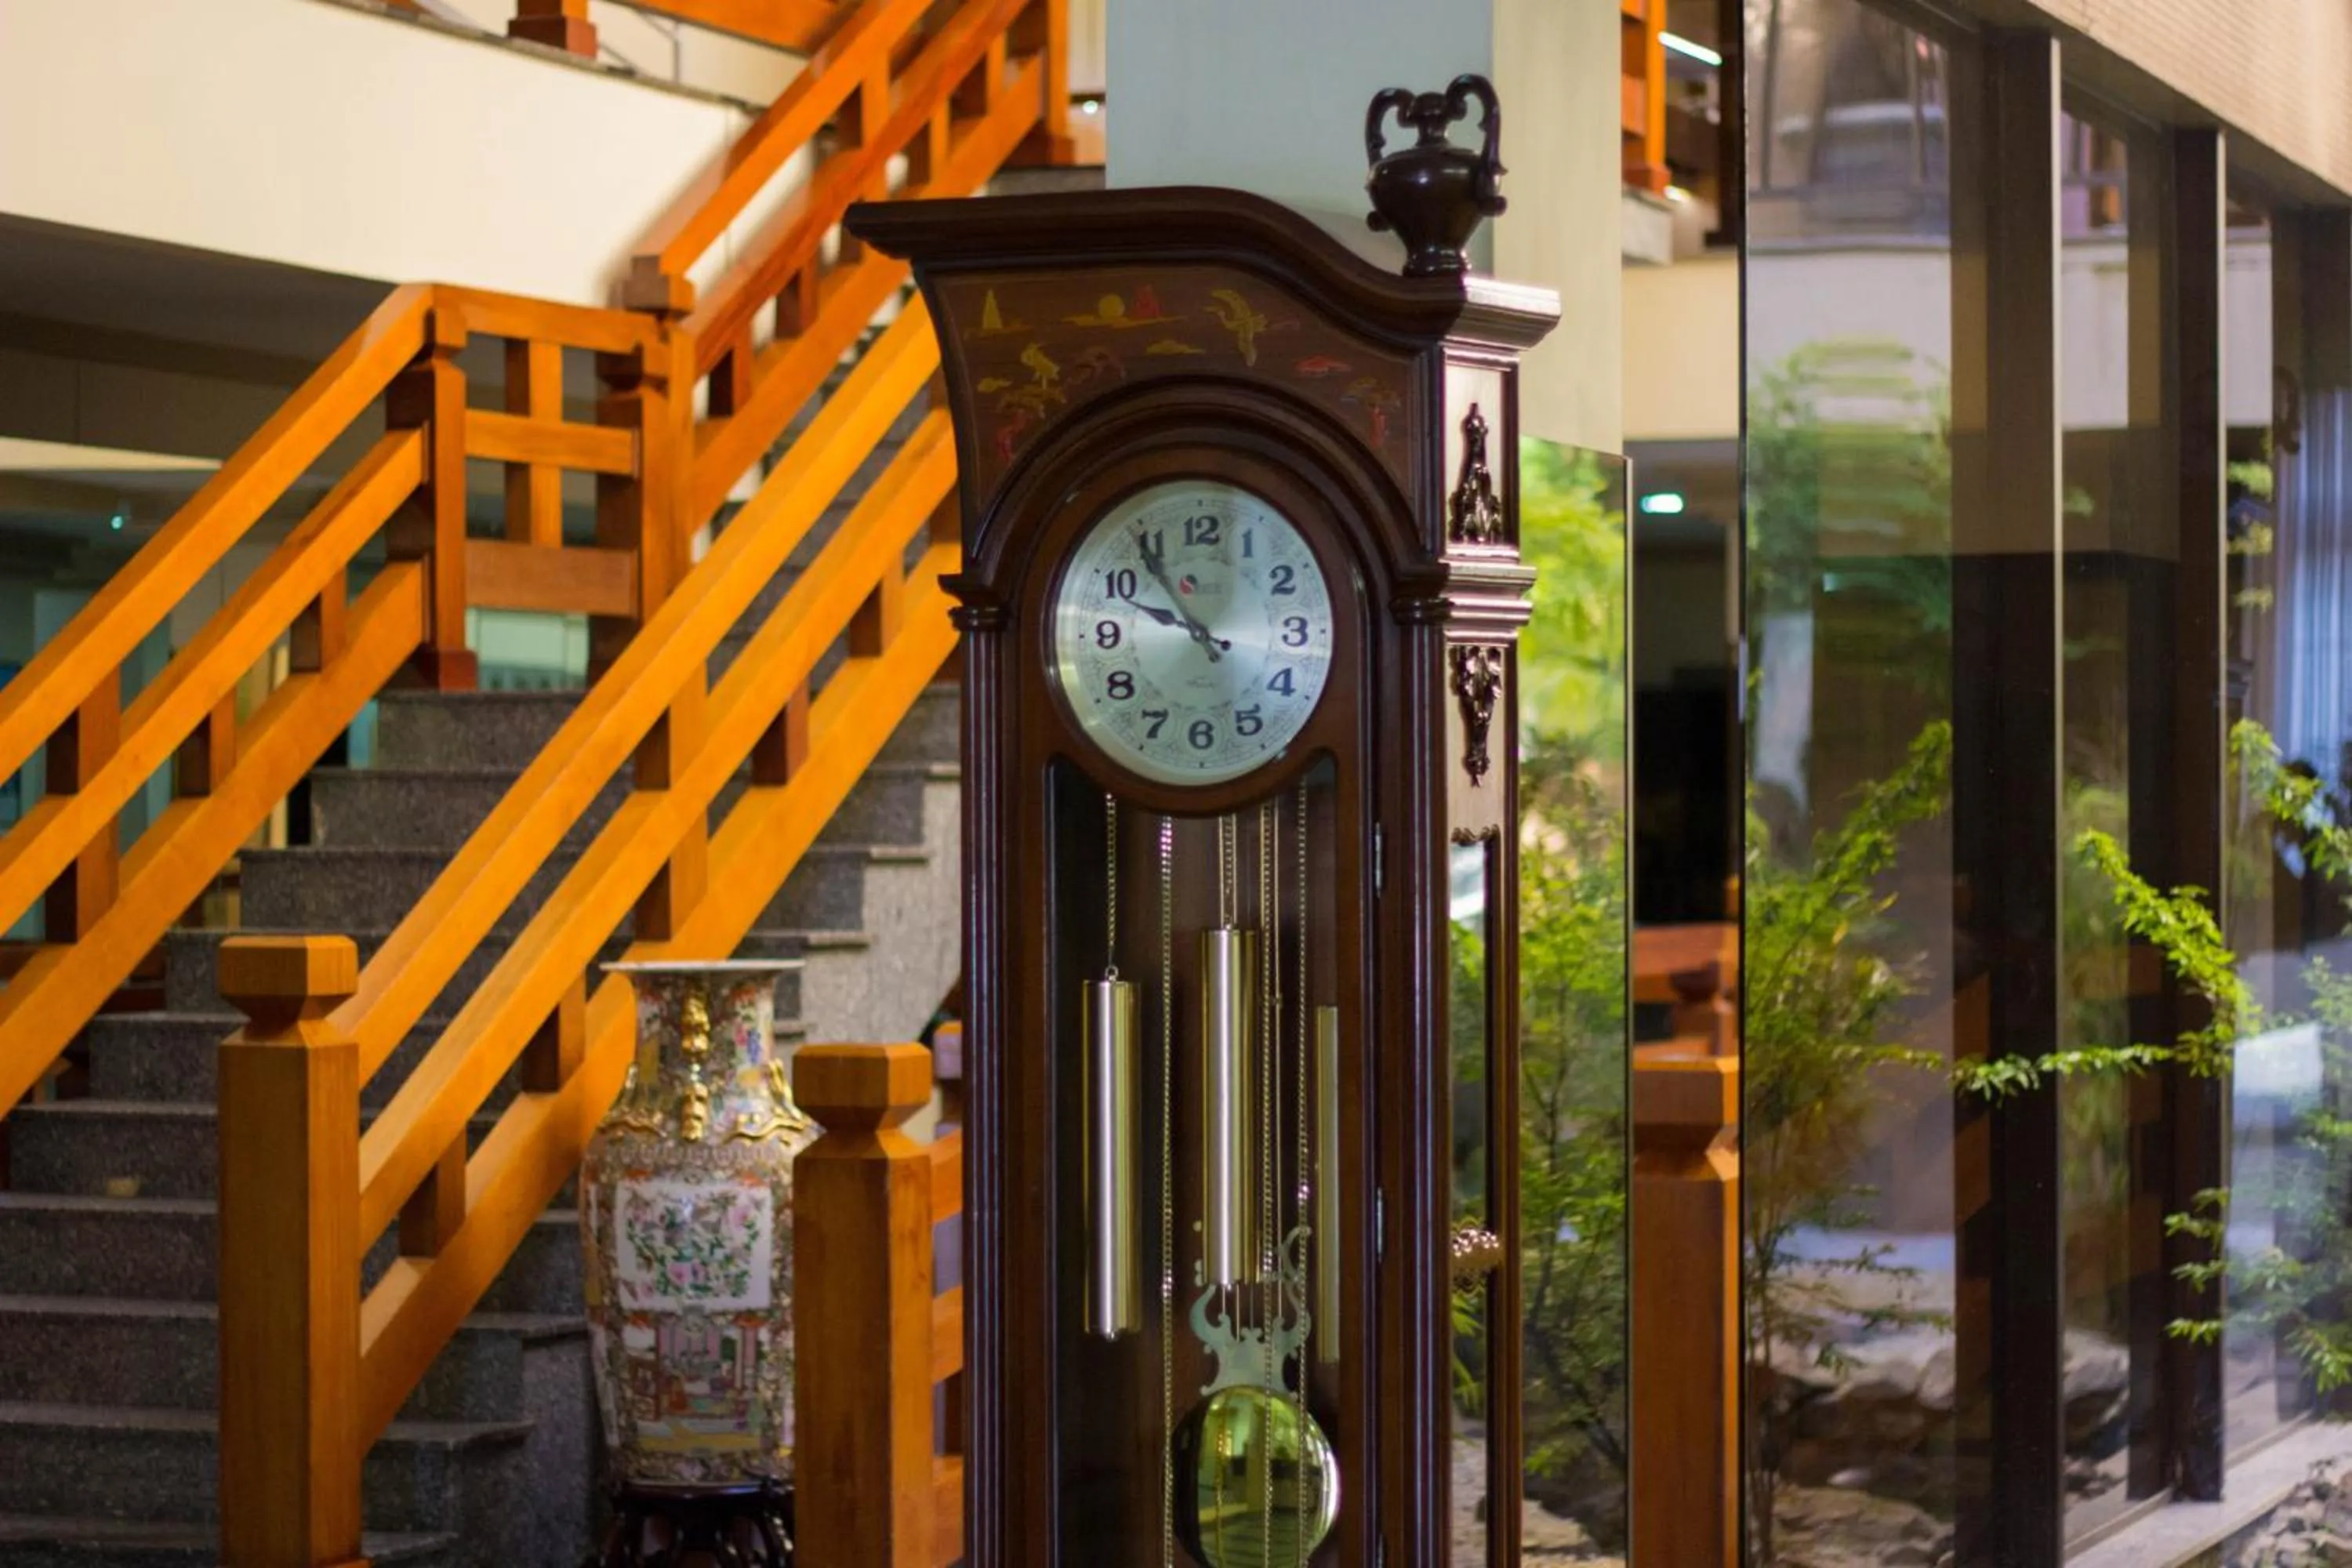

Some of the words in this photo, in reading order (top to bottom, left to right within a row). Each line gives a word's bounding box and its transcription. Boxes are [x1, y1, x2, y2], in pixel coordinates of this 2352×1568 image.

[1139, 529, 1163, 559] 11
[1183, 516, 1220, 546] 12
[1242, 528, 1254, 558] 1
[1105, 568, 1136, 599] 10
[1269, 564, 1296, 595] 2
[1096, 620, 1120, 649] 9
[1282, 616, 1308, 647] 3
[1106, 670, 1134, 699] 8
[1266, 668, 1296, 697] 4
[1142, 709, 1169, 739] 7
[1235, 702, 1263, 736] 5
[1189, 720, 1214, 750] 6
